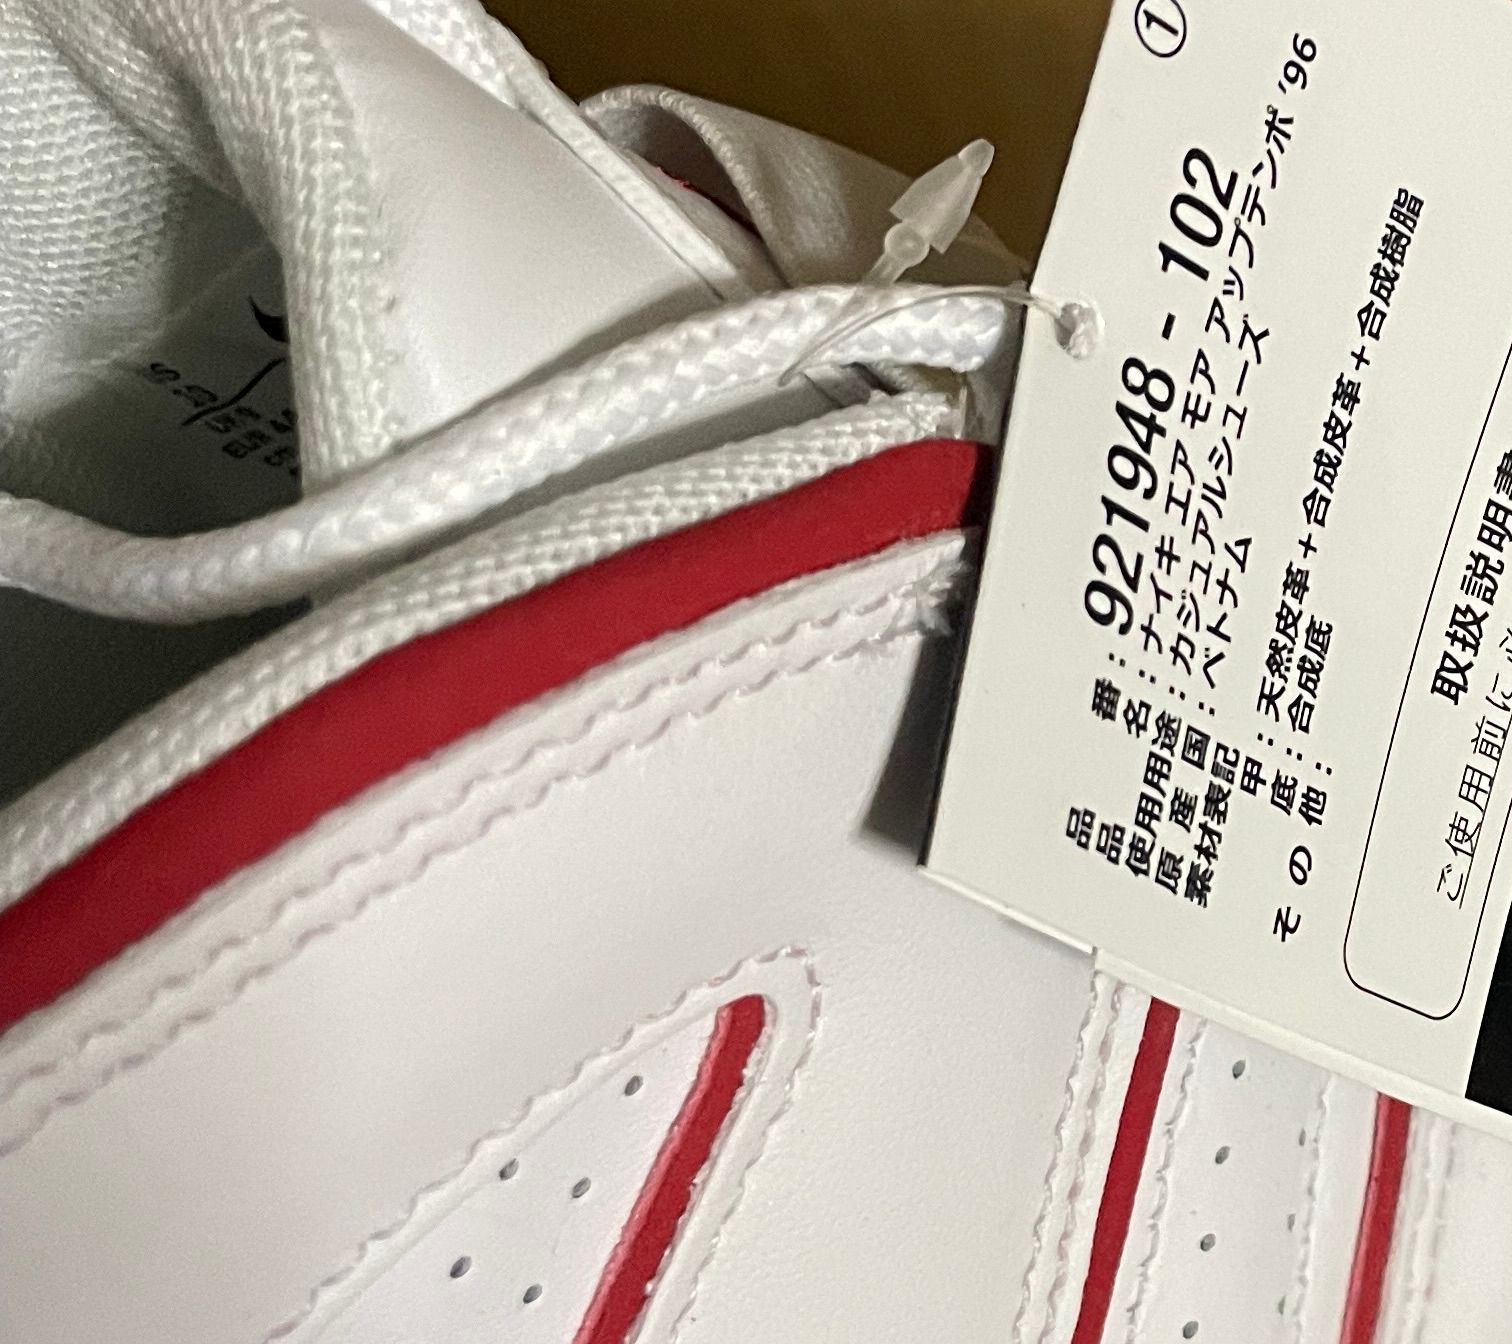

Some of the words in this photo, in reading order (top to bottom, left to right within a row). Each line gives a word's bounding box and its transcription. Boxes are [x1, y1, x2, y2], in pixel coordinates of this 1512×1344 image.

[1084, 357, 1176, 636] 921948
[1158, 147, 1239, 282] 102
[1202, 537, 1253, 690] ベトナム
[1183, 741, 1241, 909] 素材表記
